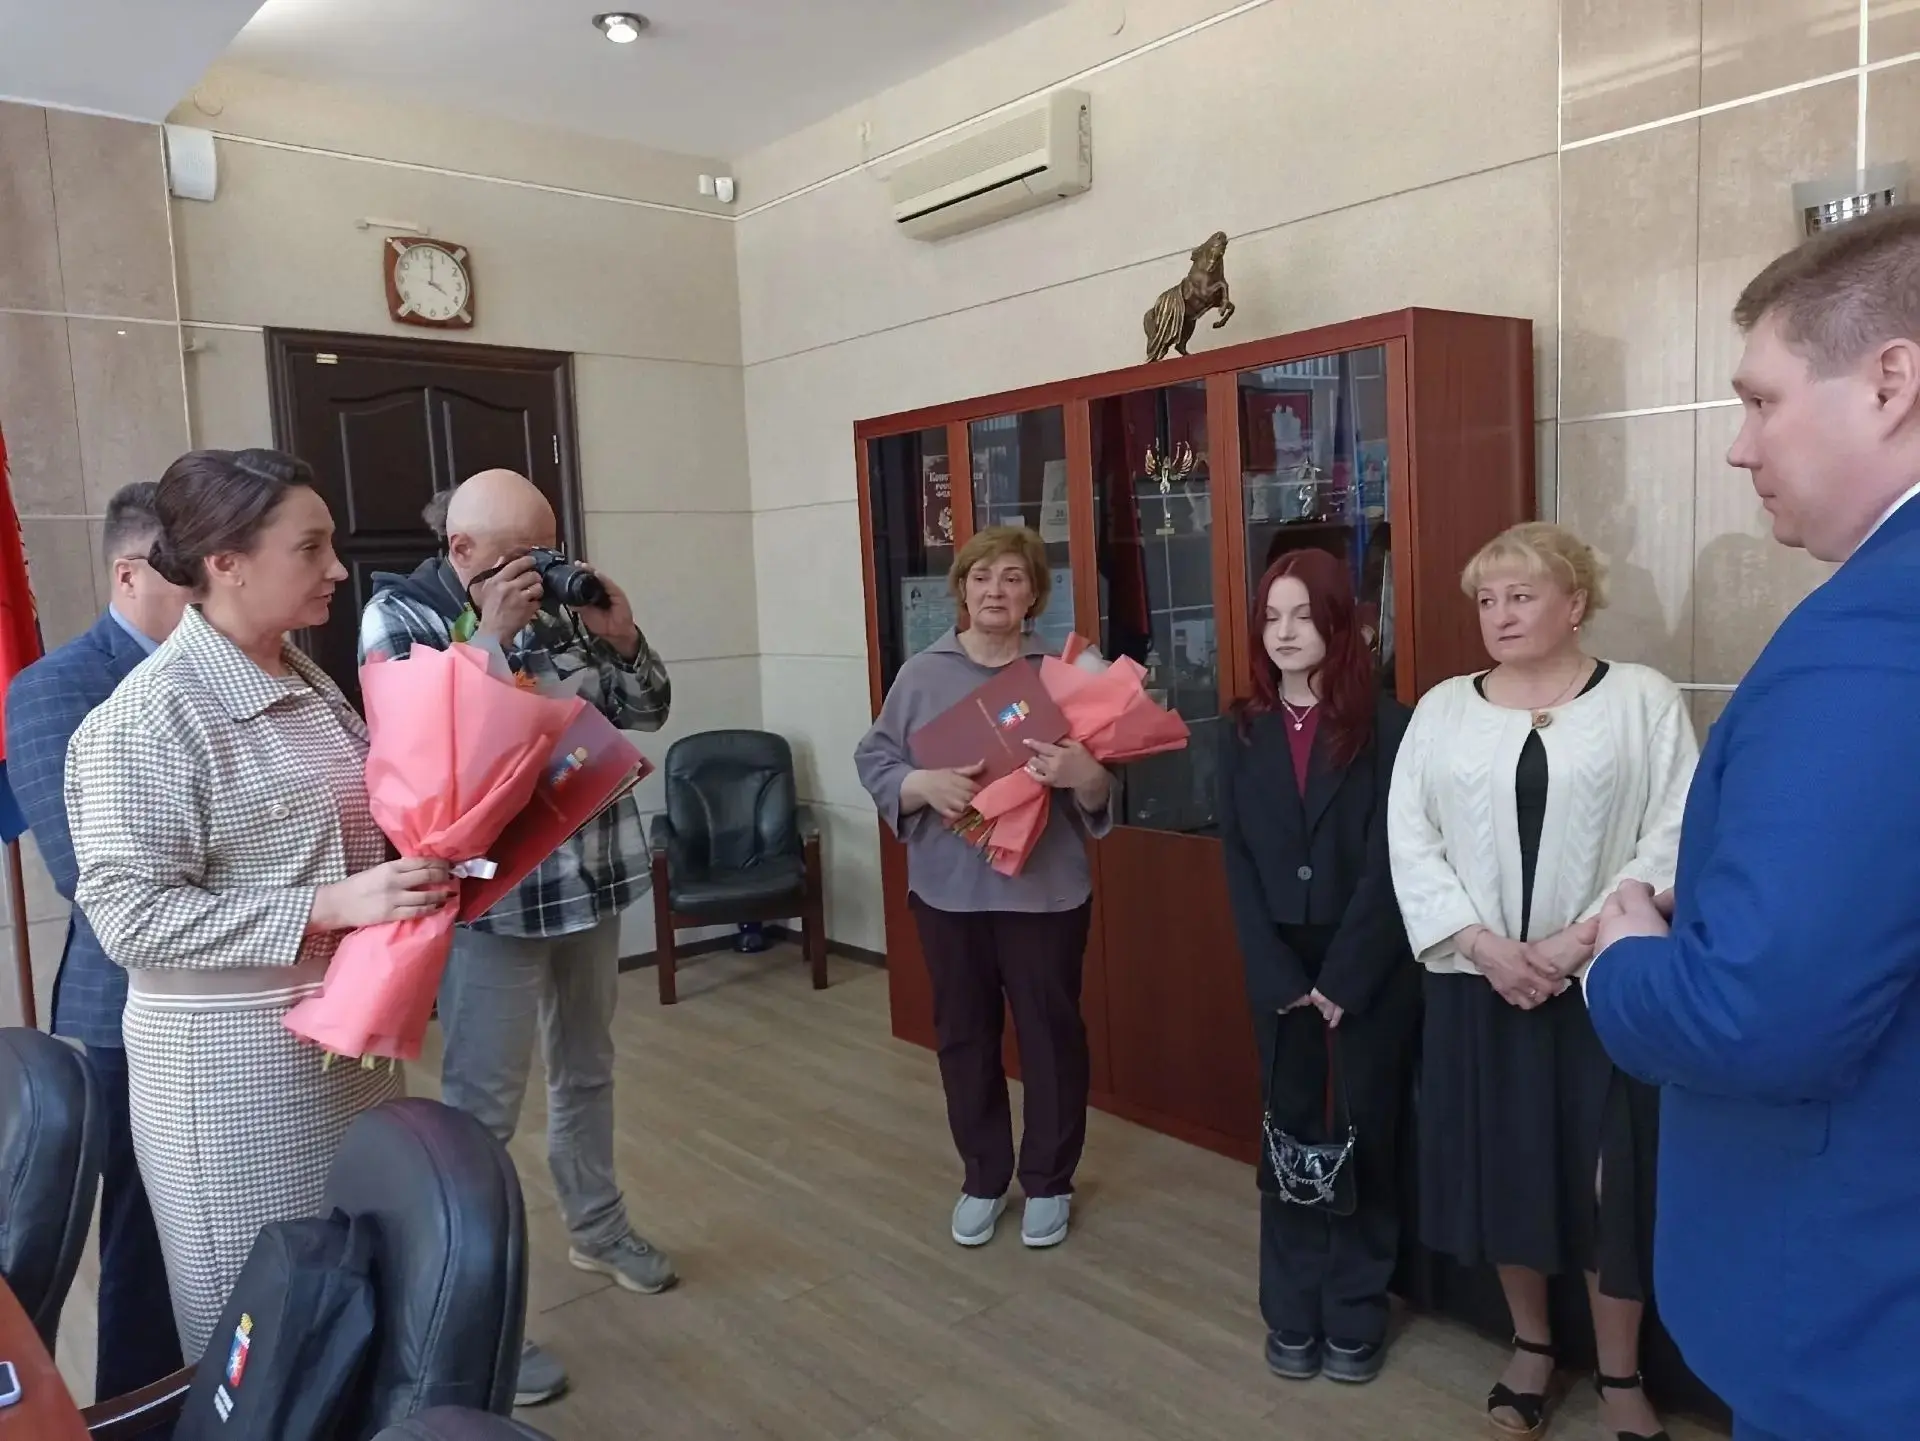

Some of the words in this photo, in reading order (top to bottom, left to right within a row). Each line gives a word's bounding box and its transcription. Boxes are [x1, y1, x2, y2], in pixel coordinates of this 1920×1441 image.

[410, 250, 419, 260] 11
[423, 249, 433, 259] 12
[452, 267, 458, 277] 2
[455, 282, 462, 292] 3
[453, 296, 459, 306] 4
[429, 308, 436, 317] 6
[443, 306, 450, 315] 5
